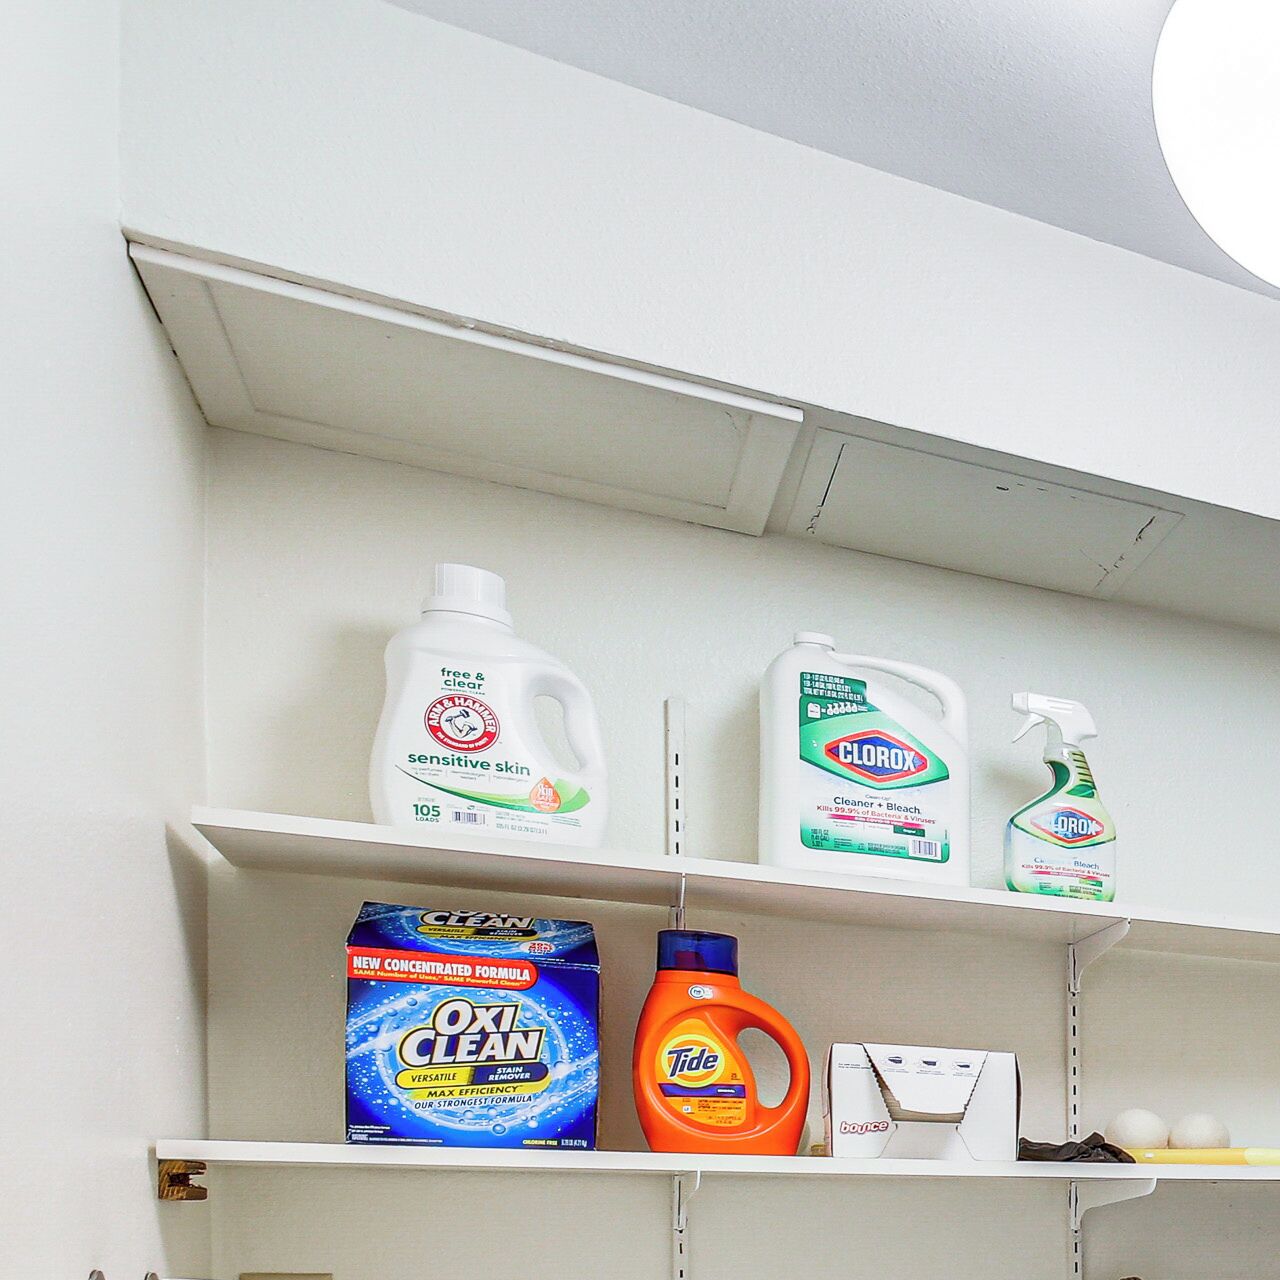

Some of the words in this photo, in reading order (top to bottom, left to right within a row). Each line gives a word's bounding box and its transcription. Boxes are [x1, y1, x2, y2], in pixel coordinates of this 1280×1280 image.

[441, 668, 471, 679] free
[476, 672, 485, 681] &
[444, 678, 482, 690] clear
[428, 704, 446, 727] ARM
[442, 698, 454, 708] &
[454, 697, 497, 733] HAMMER
[408, 753, 491, 770] sensitive
[496, 761, 530, 776] skin
[838, 741, 916, 772] CLOROX
[413, 804, 440, 817] 105
[834, 797, 874, 808] Cleaner
[887, 802, 920, 814] Bleach
[422, 911, 534, 928] CLEAN
[353, 956, 381, 969] NEW
[384, 959, 472, 976] CONCENTRATED
[475, 966, 531, 981] FORMULA
[434, 1000, 516, 1035] OXI
[401, 1028, 540, 1066] CLEAN
[668, 1047, 718, 1077] Tide
[411, 1073, 456, 1082] VERSATILE
[488, 1072, 530, 1081] REMOVER
[427, 1090, 457, 1098] MAX
[459, 1086, 518, 1096] EFFICIENCY
[437, 1100, 487, 1108] STRONGEST
[490, 1096, 532, 1104] FORMULA
[840, 1120, 889, 1134] bounce
